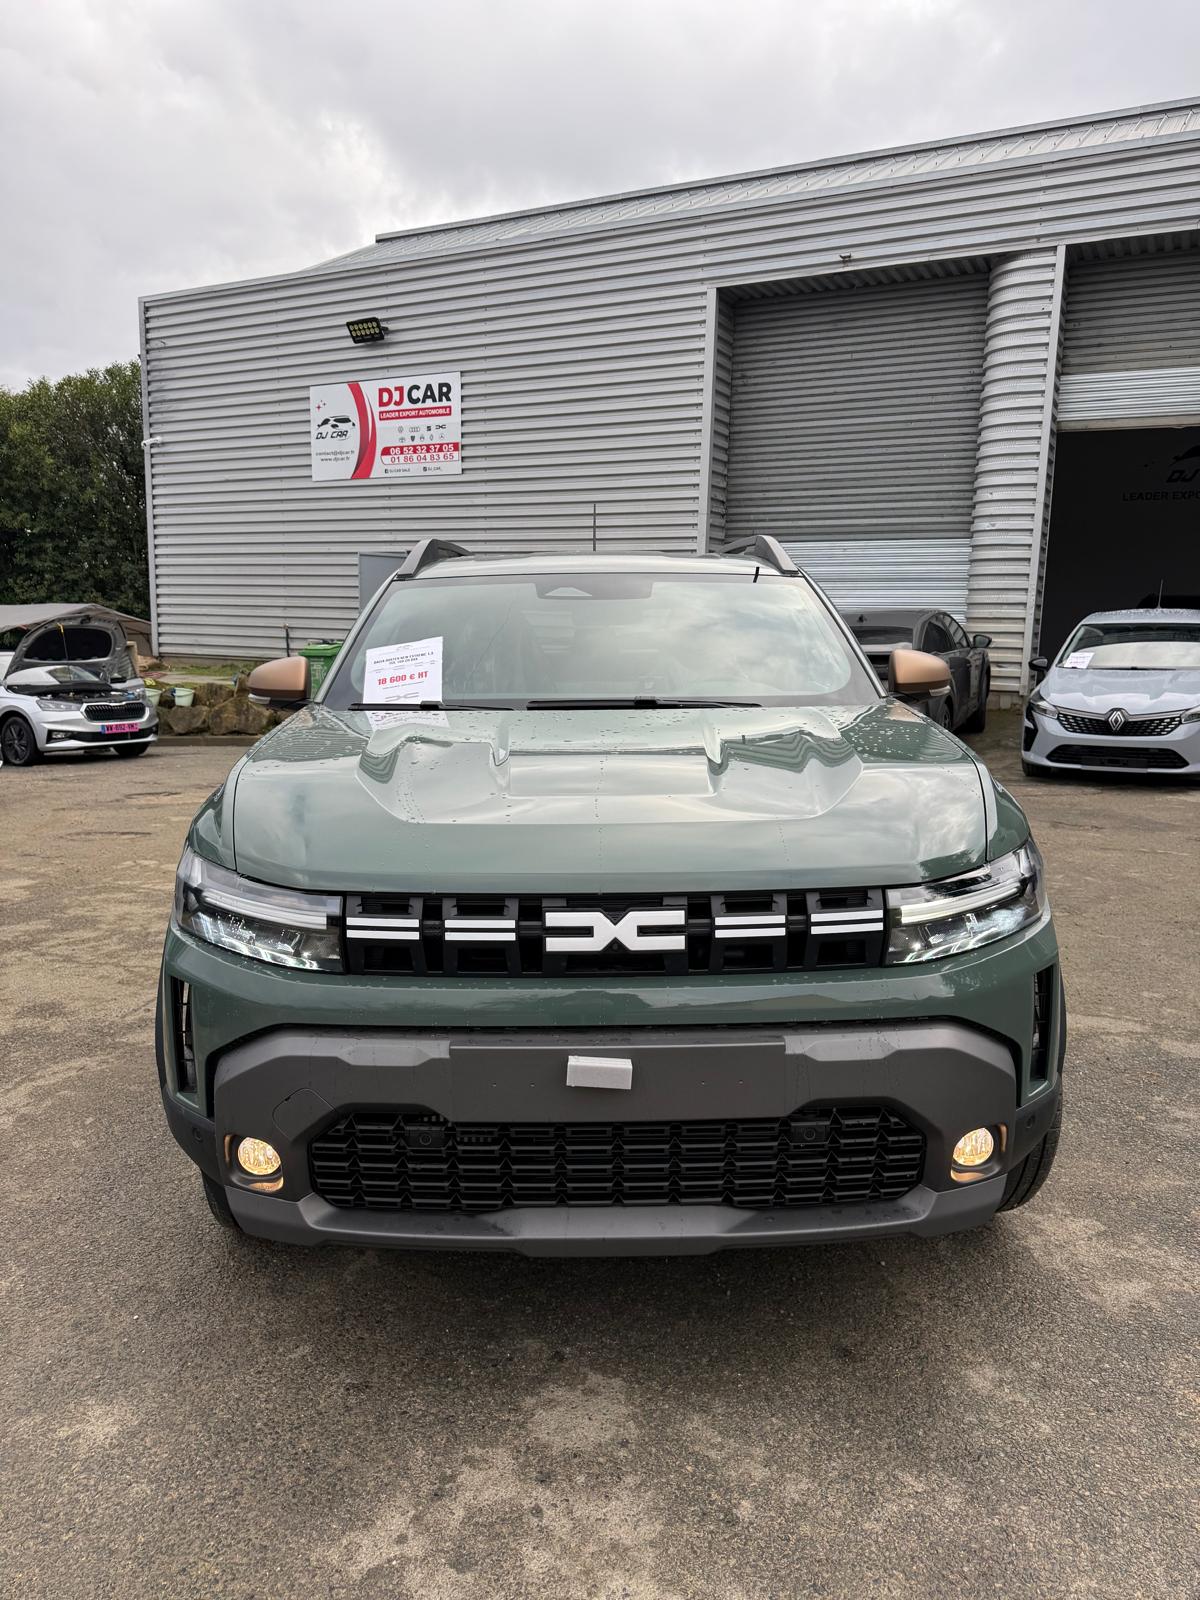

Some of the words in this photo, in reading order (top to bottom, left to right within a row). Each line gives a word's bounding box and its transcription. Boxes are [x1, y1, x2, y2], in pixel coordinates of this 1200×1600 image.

[378, 385, 404, 407] DJ
[407, 382, 452, 404] CAR
[380, 411, 399, 419] LEADER
[419, 408, 450, 416] AUTOMOBILE
[316, 431, 328, 440] DJ
[330, 430, 349, 439] CAR
[390, 447, 400, 455] 06
[403, 446, 414, 454] 52
[416, 445, 427, 453] 32
[442, 444, 454, 452] 05
[391, 456, 400, 464] 01
[403, 455, 414, 463] 86
[416, 454, 427, 462] 04
[430, 453, 440, 461] 83
[1165, 468, 1200, 483] DJ
[1122, 491, 1169, 501] LEADER
[377, 677, 387, 685] 18
[389, 674, 407, 683] 600
[418, 671, 428, 679] HT
